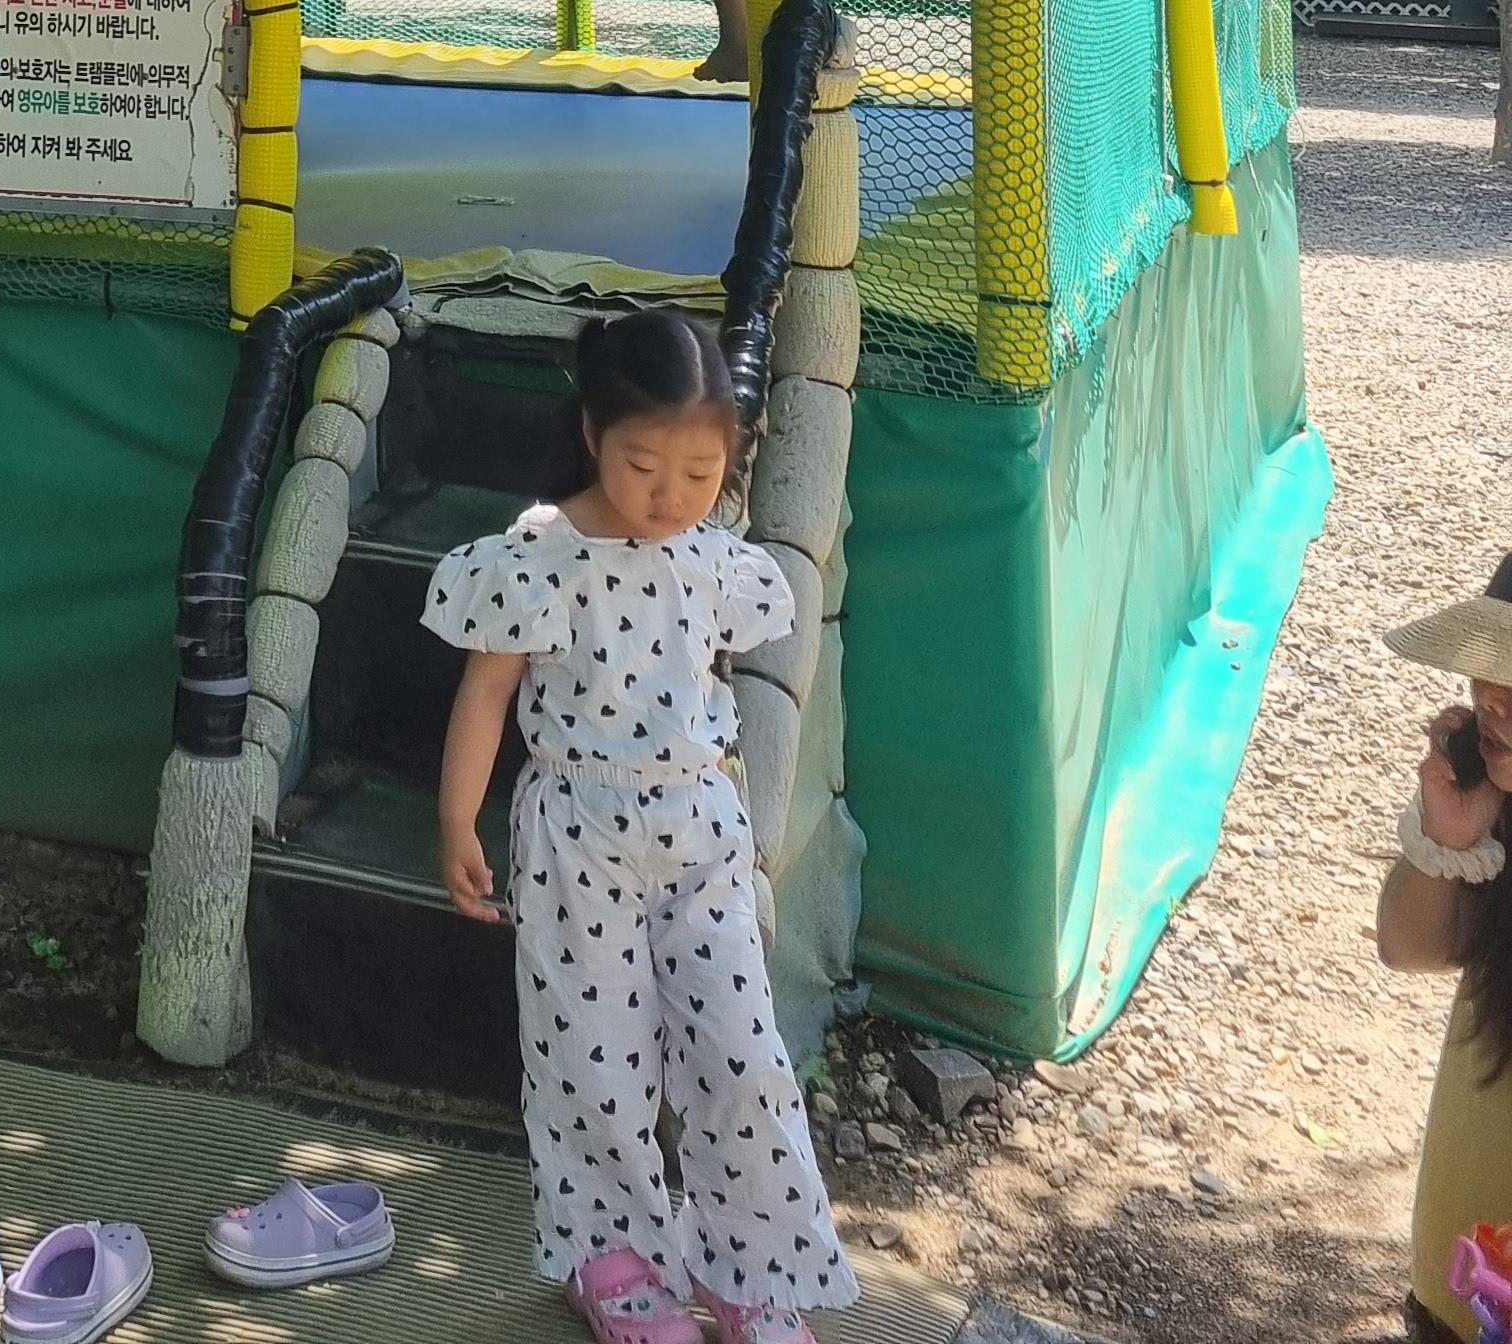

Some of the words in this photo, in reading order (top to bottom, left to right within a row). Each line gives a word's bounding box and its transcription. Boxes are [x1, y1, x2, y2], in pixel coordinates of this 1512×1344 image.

[14, 11, 42, 35] 유의
[47, 13, 91, 38] 하시기
[96, 15, 160, 41] 바랍니다.
[17, 58, 71, 84] 보호자는
[74, 61, 144, 87] 트램플린에
[148, 64, 190, 90] 의무적
[17, 89, 70, 114] 영유아를
[73, 91, 141, 118] 보호하여야
[144, 94, 189, 121] 합니다.
[31, 134, 60, 159] 지켜
[65, 136, 81, 160] 봐
[85, 138, 133, 162] 주세요
